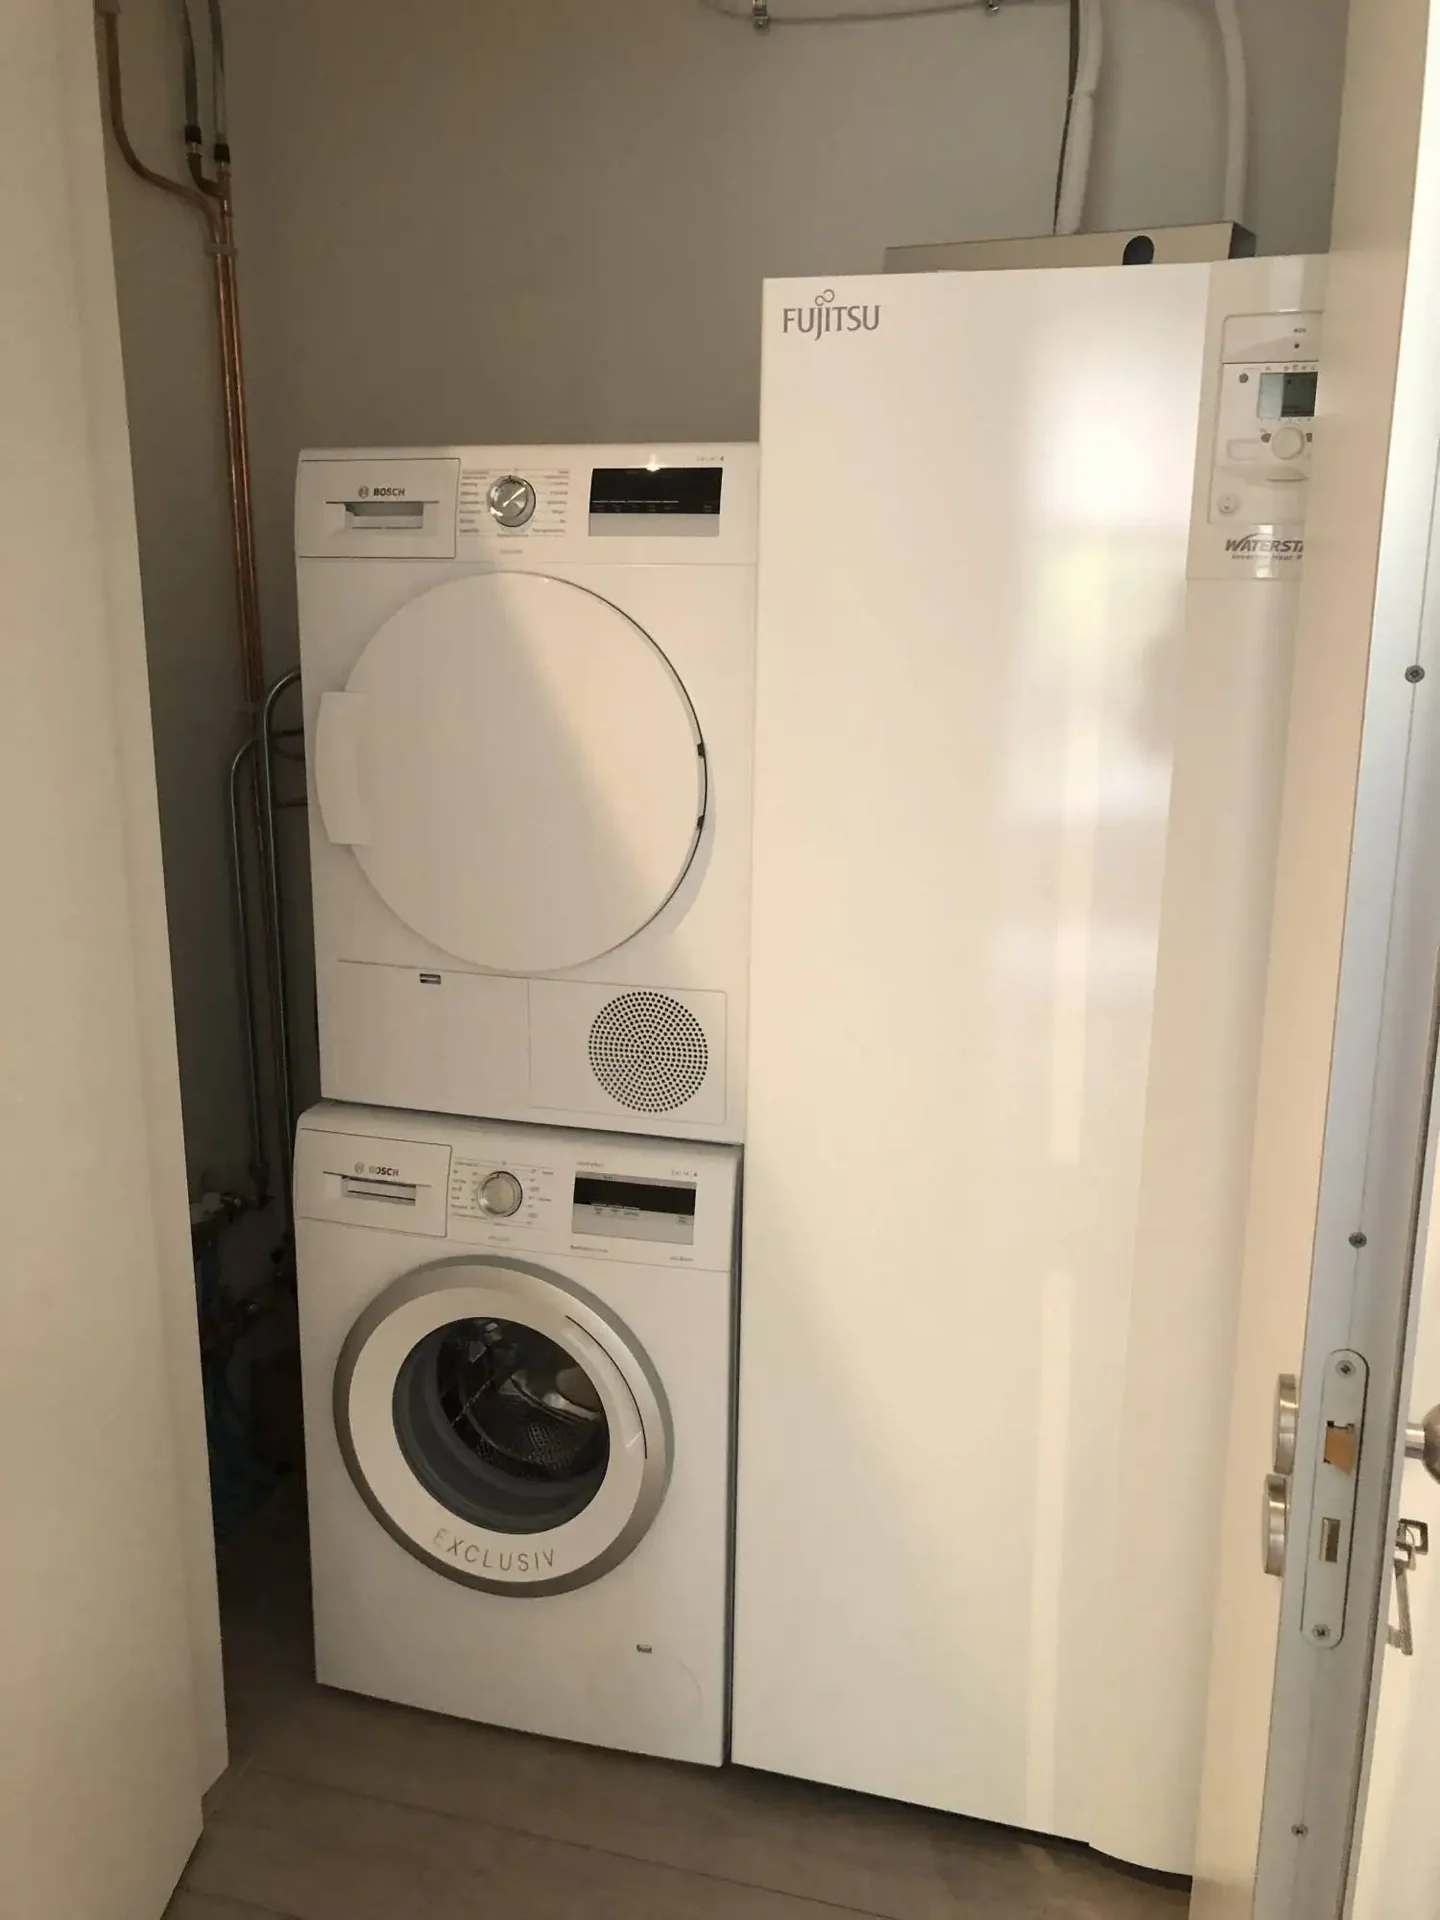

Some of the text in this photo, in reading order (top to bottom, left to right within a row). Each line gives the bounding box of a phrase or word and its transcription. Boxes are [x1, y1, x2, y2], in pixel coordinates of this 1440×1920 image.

[783, 290, 880, 341] FUJITSU
[373, 486, 405, 497] BOSCH
[369, 1165, 400, 1177] BOSCH
[432, 1527, 555, 1572] EXCLUSIV
